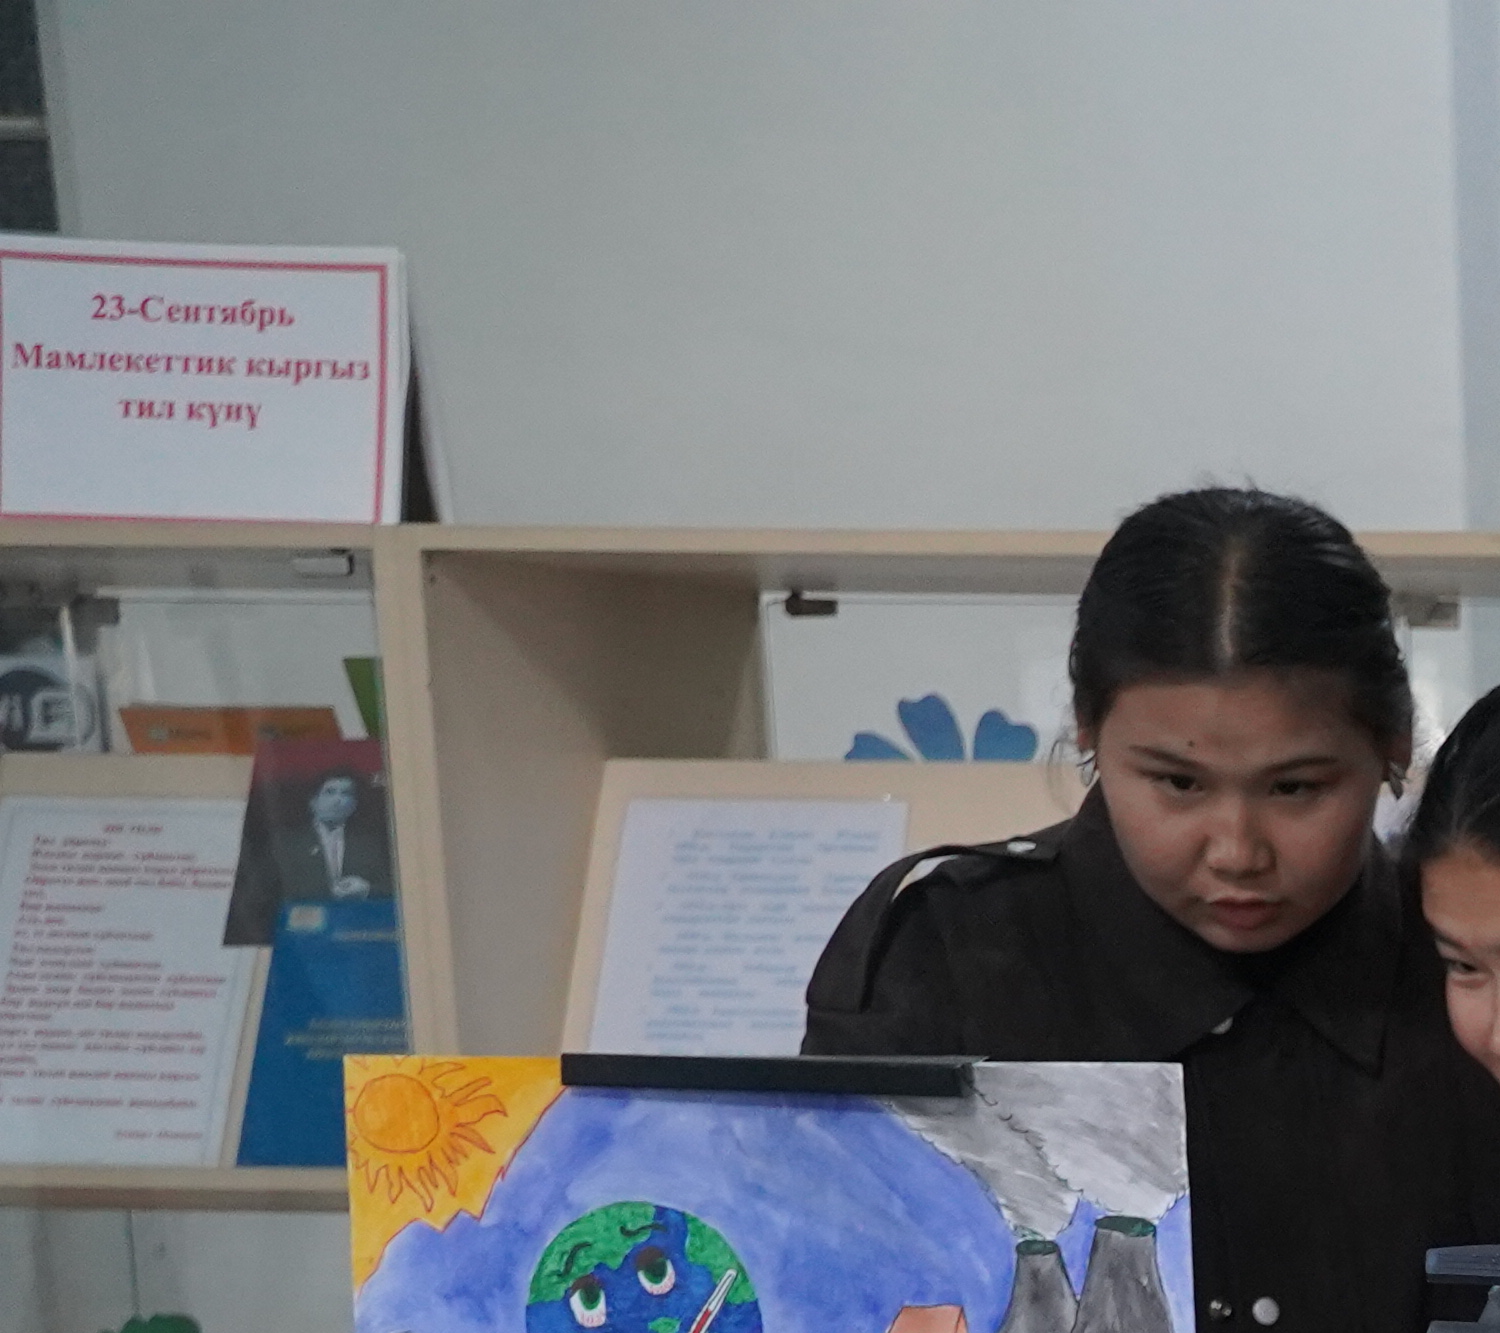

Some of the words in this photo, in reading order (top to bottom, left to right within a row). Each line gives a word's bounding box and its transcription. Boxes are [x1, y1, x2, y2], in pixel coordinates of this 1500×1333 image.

[91, 294, 295, 332] 23-Сентябрь
[11, 341, 236, 377] Мамлекеттик
[245, 357, 370, 386] кыргыз
[118, 398, 175, 419] тил
[187, 400, 261, 430] күнү
